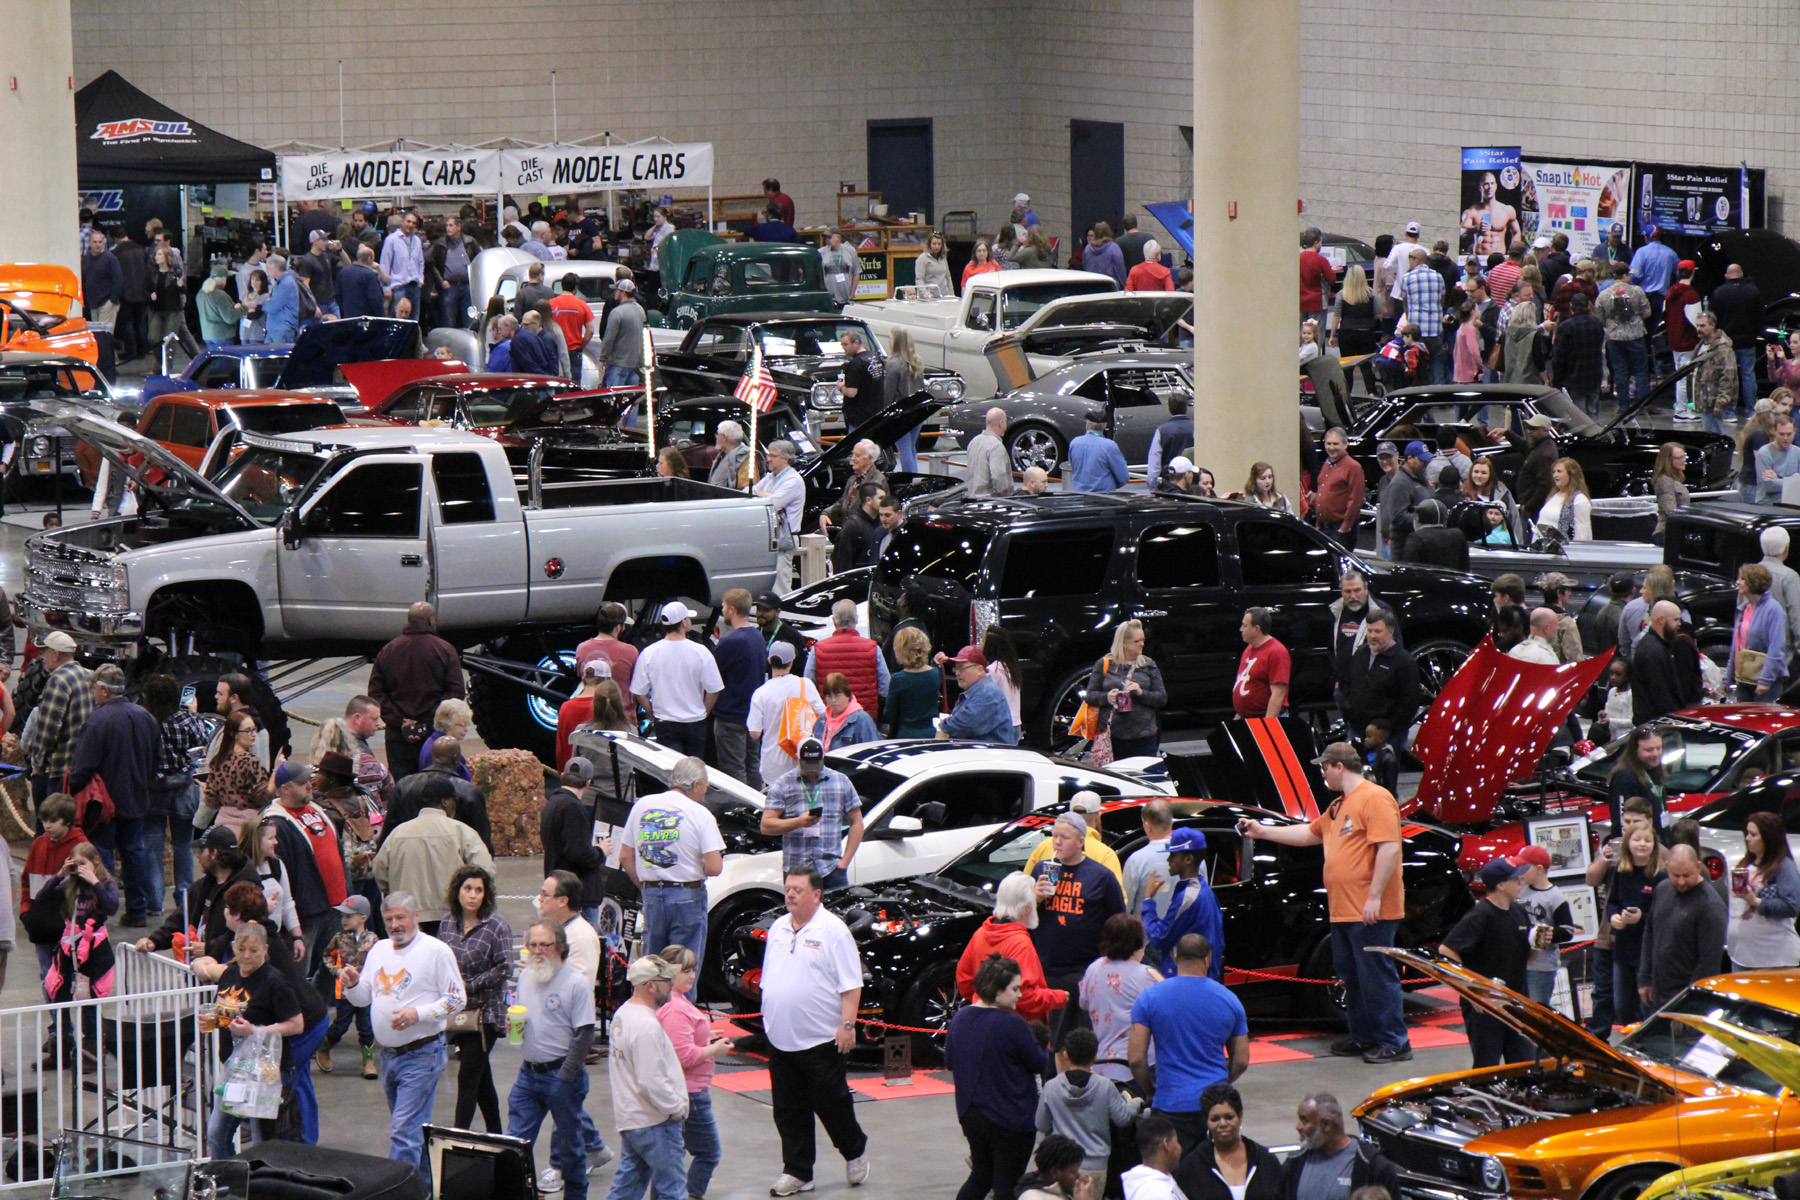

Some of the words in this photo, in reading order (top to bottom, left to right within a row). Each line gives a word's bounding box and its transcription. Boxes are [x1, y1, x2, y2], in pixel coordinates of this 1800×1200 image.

[96, 119, 192, 139] AMSOIL
[520, 157, 539, 172] DIE
[552, 156, 623, 184] MODEL
[632, 153, 686, 181] CARS
[1488, 156, 1519, 164] Relief
[311, 162, 329, 178] DIE
[341, 160, 413, 189] MODEL
[422, 159, 477, 186] CARS
[517, 168, 544, 186] CAST
[1536, 169, 1561, 187] Snap
[1563, 171, 1572, 184] It
[1582, 172, 1601, 187] Hot
[1666, 173, 1685, 181] 5Star
[1687, 174, 1703, 182] Pain
[1705, 175, 1728, 184] Relief
[306, 174, 334, 191] CAST
[1656, 716, 1755, 741] ORVETTE
[1055, 879, 1083, 897] WAR
[1045, 895, 1085, 915] EAGLE
